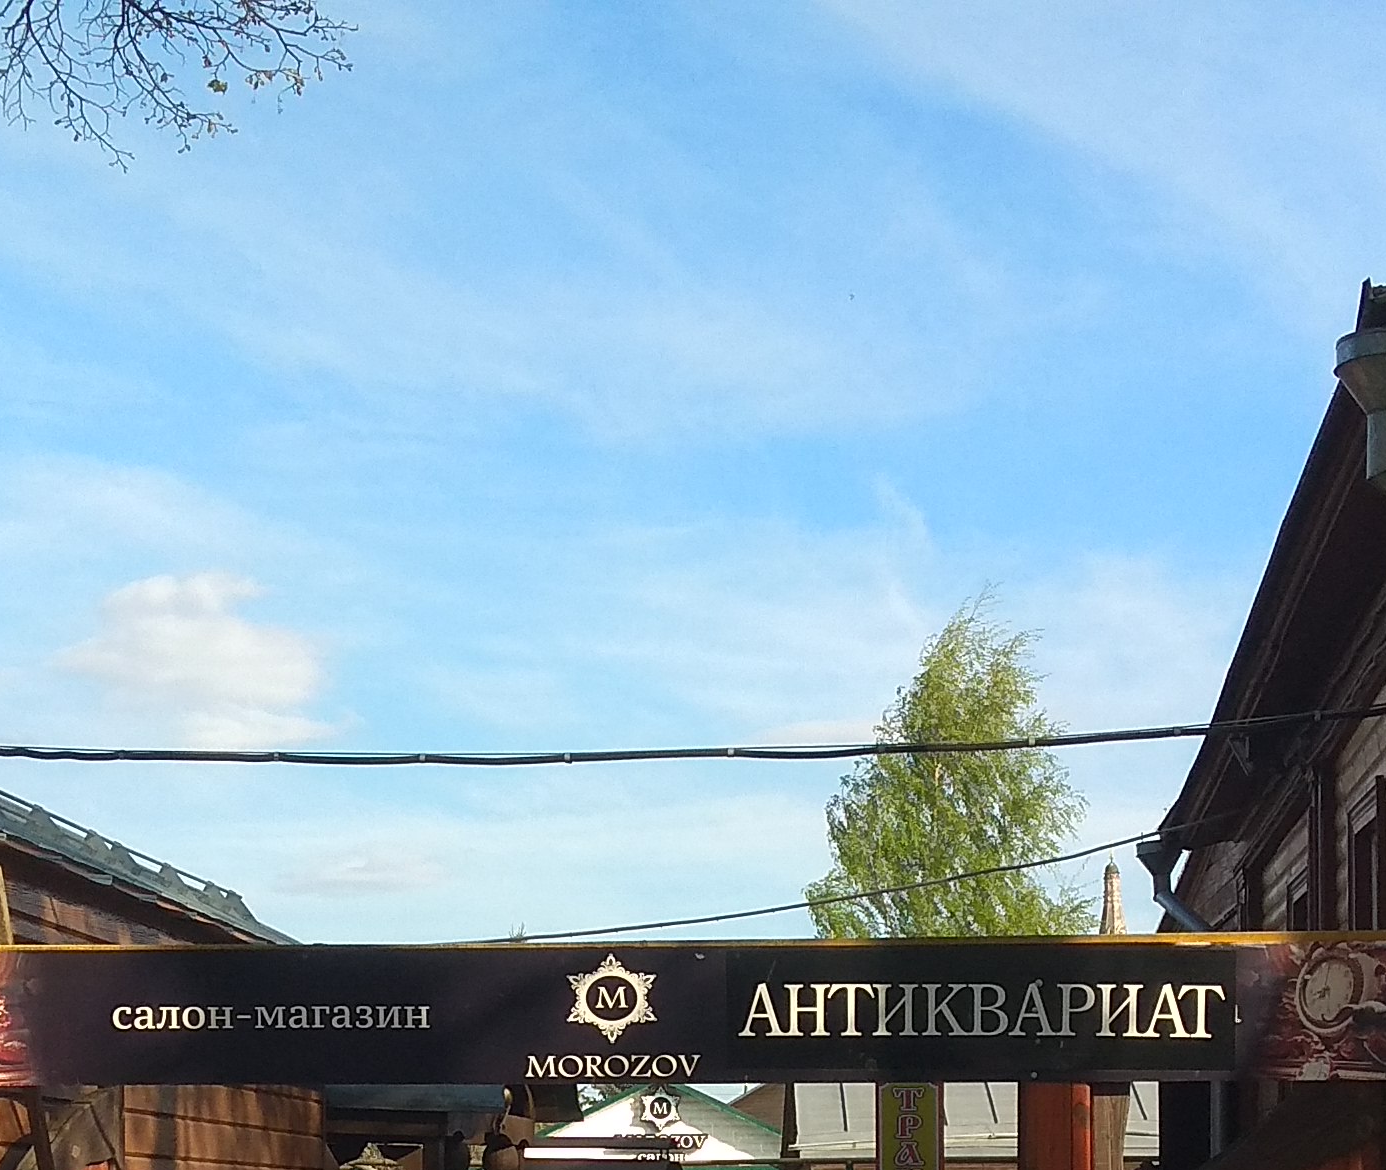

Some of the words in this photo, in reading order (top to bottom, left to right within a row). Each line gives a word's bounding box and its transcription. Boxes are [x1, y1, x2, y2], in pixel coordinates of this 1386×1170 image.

[111, 1001, 431, 1033] салон-магазин
[738, 982, 1226, 1039] АНТИКВАРИАТ
[524, 1054, 701, 1079] MOROZOV
